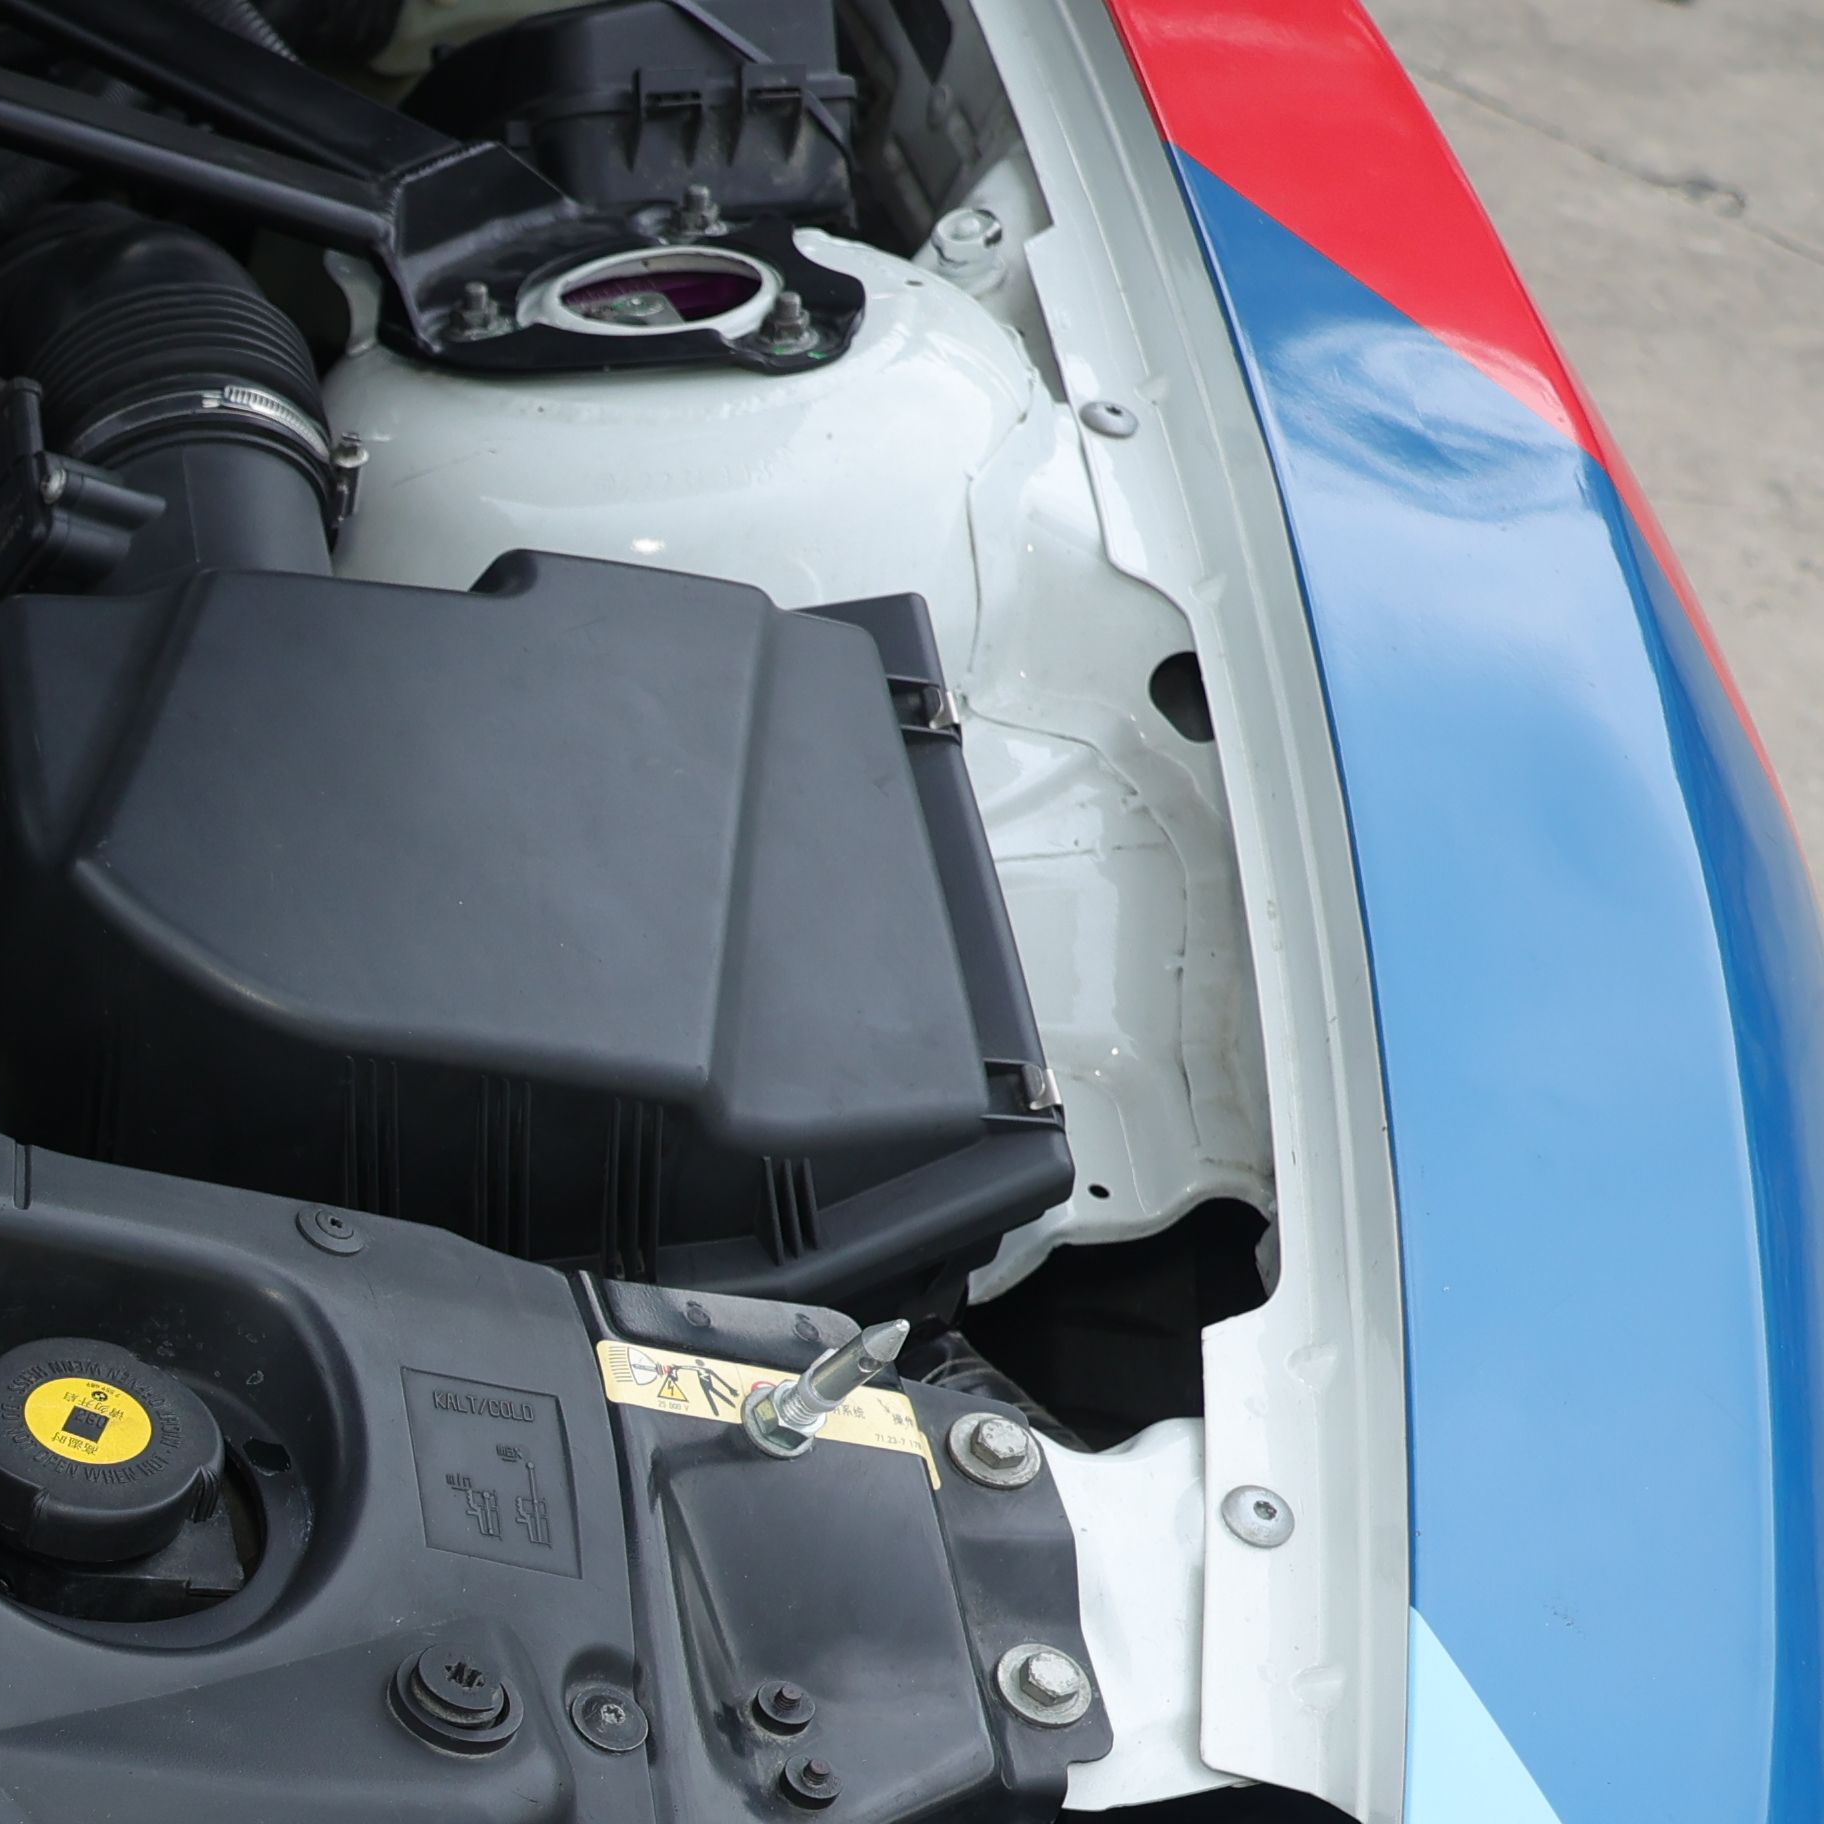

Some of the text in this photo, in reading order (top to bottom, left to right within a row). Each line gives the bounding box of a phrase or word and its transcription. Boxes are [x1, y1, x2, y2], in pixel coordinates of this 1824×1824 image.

[433, 1391, 535, 1423] KALT/COLD
[32, 1450, 79, 1477] OPEN
[84, 1464, 137, 1485] WHEN
[139, 1453, 170, 1477] HOT
